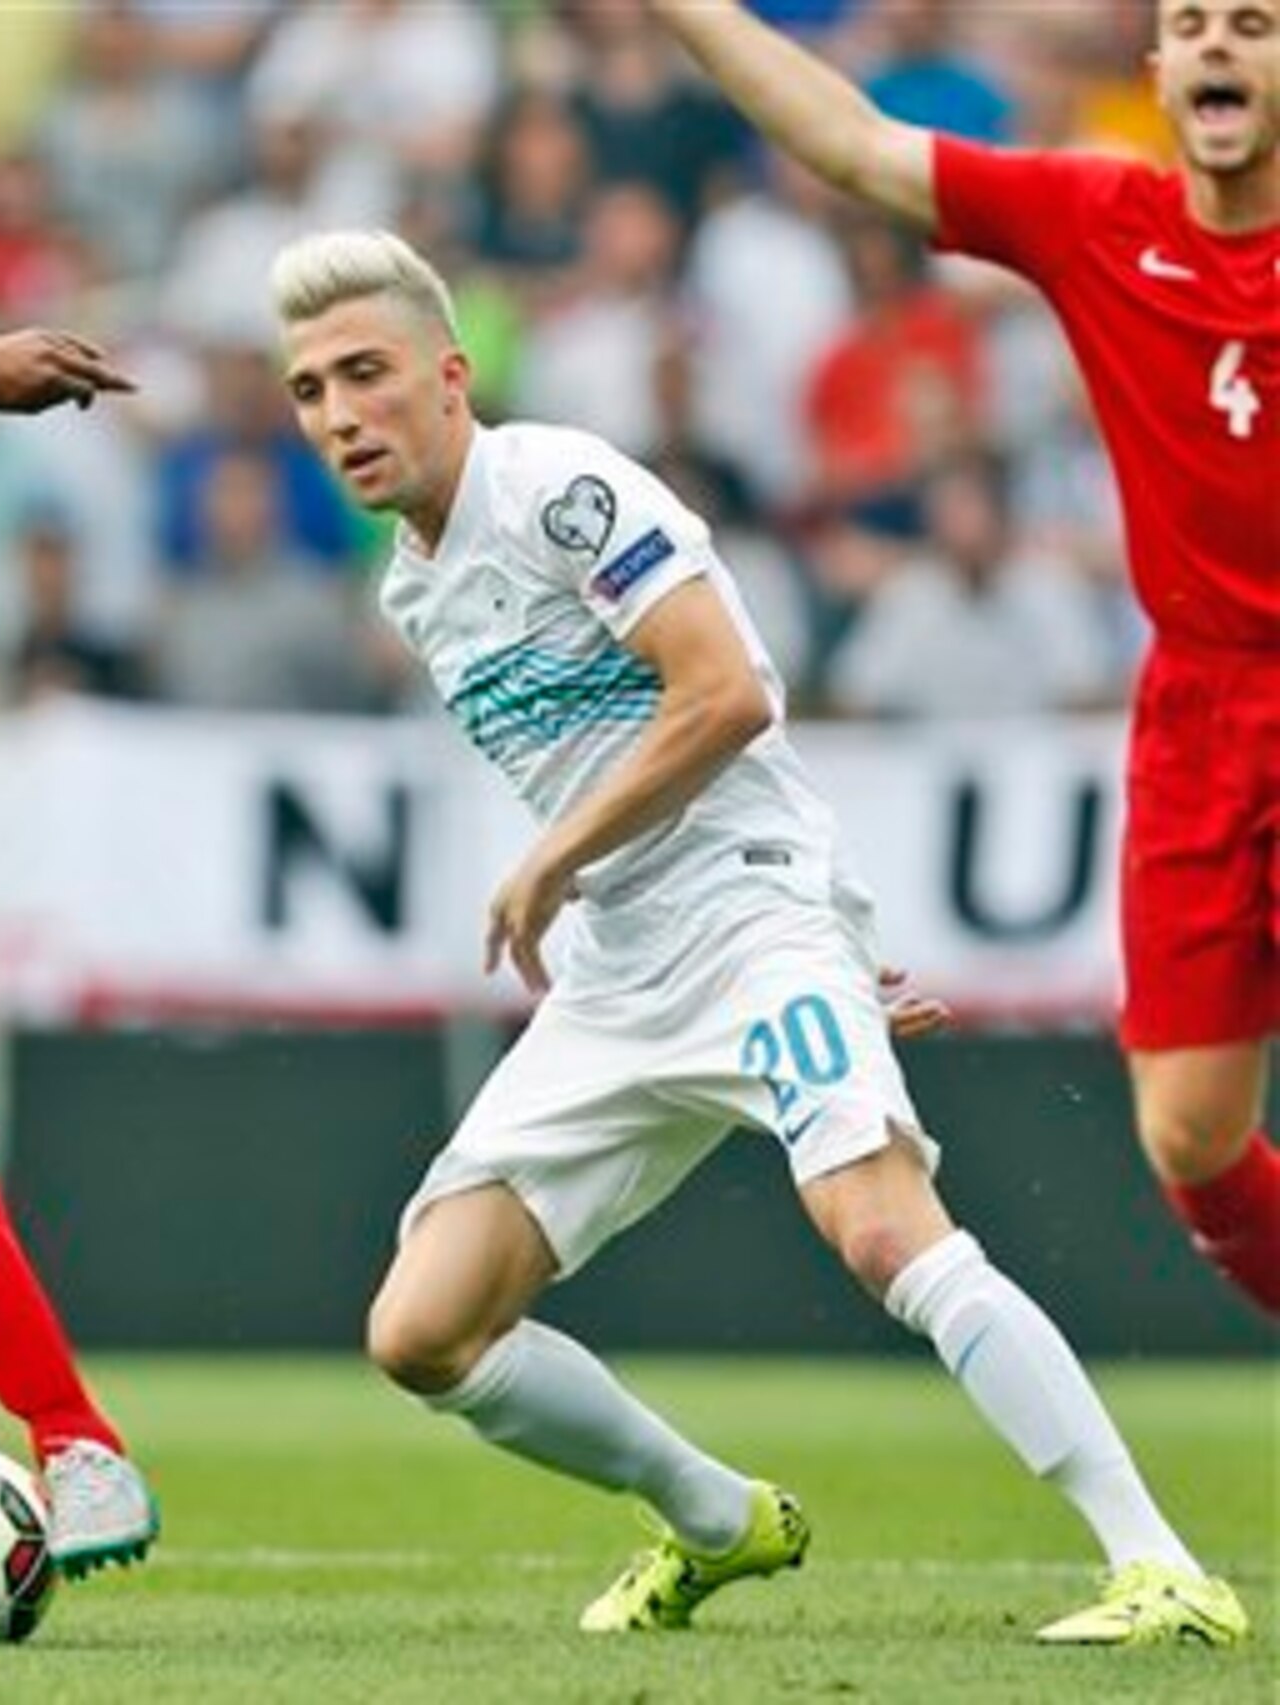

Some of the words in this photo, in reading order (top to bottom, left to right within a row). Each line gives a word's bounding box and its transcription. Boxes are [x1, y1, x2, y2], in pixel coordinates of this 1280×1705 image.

[1209, 340, 1261, 438] 4
[259, 775, 412, 938] N
[950, 777, 1100, 944] U
[740, 994, 851, 1118] 20
